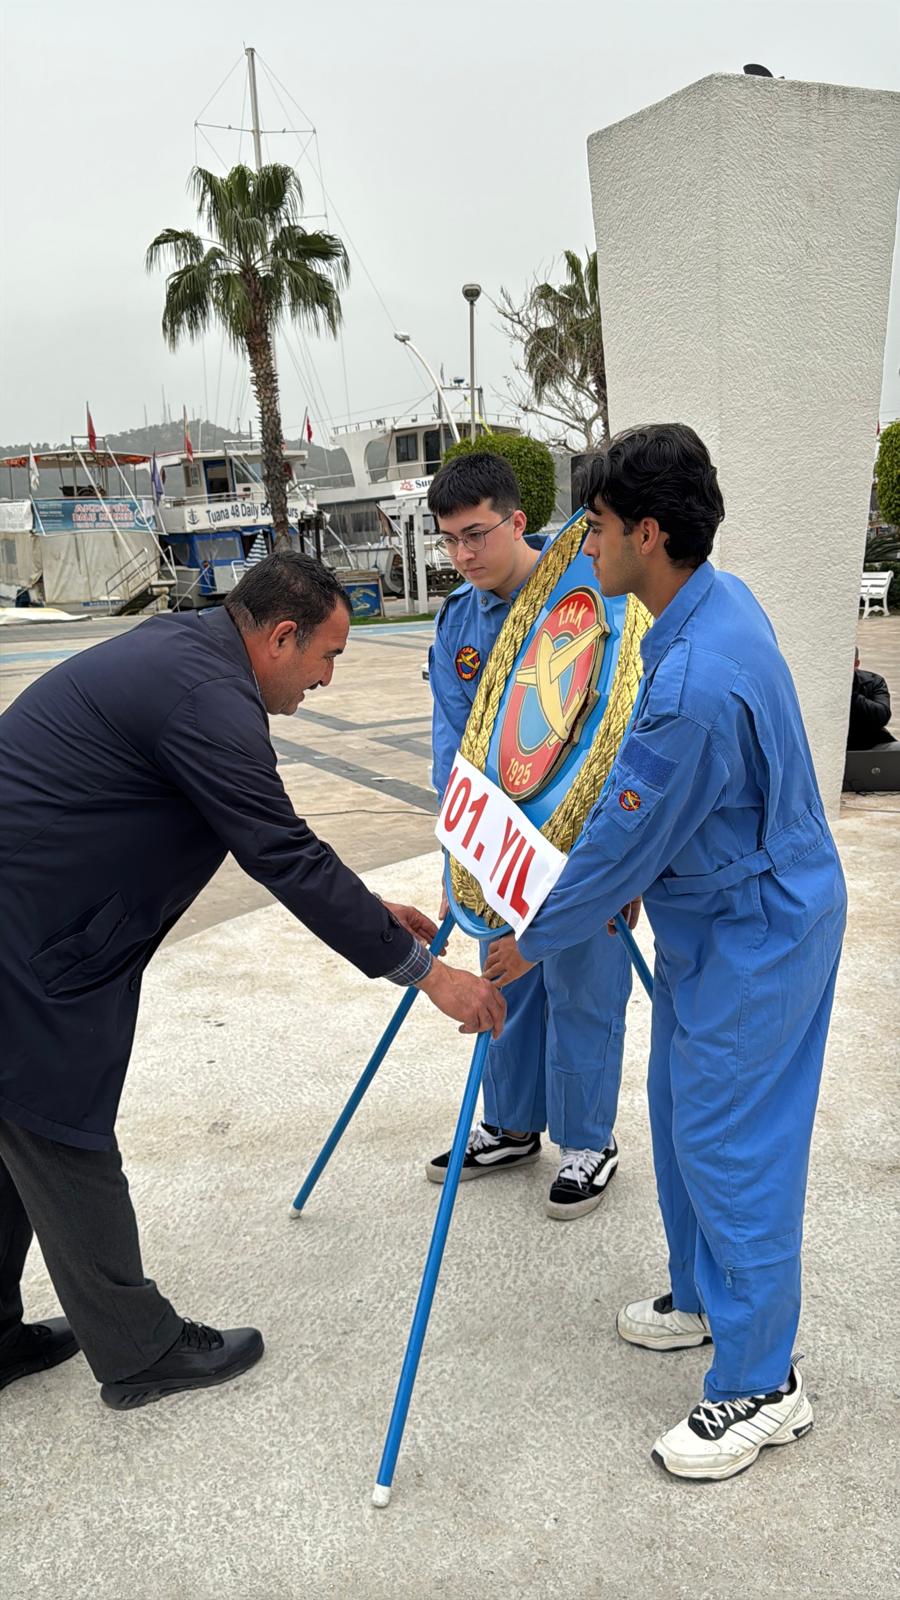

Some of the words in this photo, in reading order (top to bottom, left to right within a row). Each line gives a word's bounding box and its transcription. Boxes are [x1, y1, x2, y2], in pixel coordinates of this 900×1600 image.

[206, 507, 229, 523] Tuana
[230, 504, 240, 518] 48
[241, 503, 259, 519] Daily
[506, 757, 533, 786] 1925
[489, 815, 537, 921] YIL
